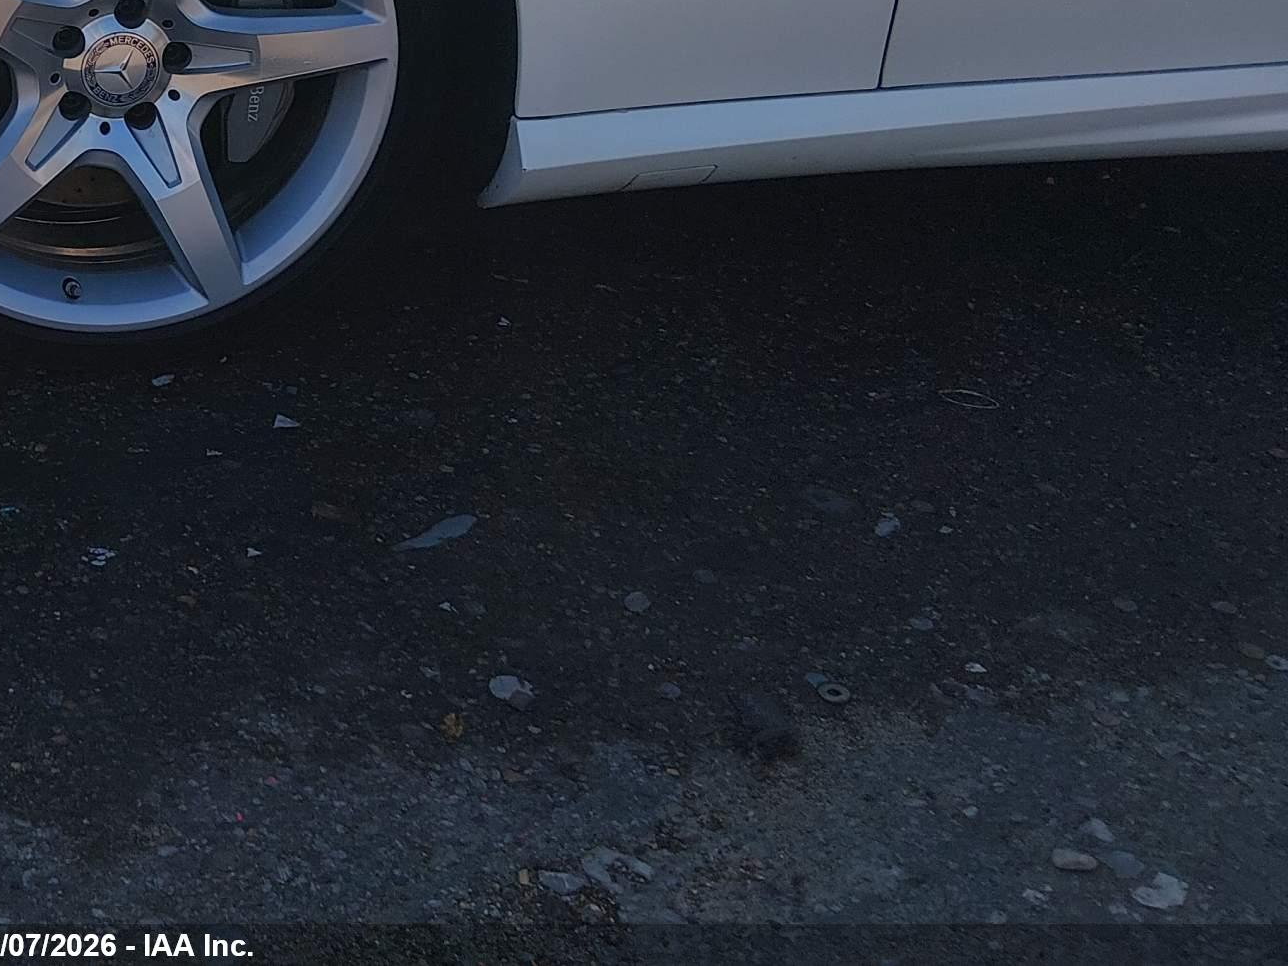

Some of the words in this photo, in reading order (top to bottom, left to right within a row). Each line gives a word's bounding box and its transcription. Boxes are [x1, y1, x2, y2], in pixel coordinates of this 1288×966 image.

[109, 35, 155, 64] MERCEDES
[92, 87, 120, 103] BENZ
[247, 85, 265, 122] Benz
